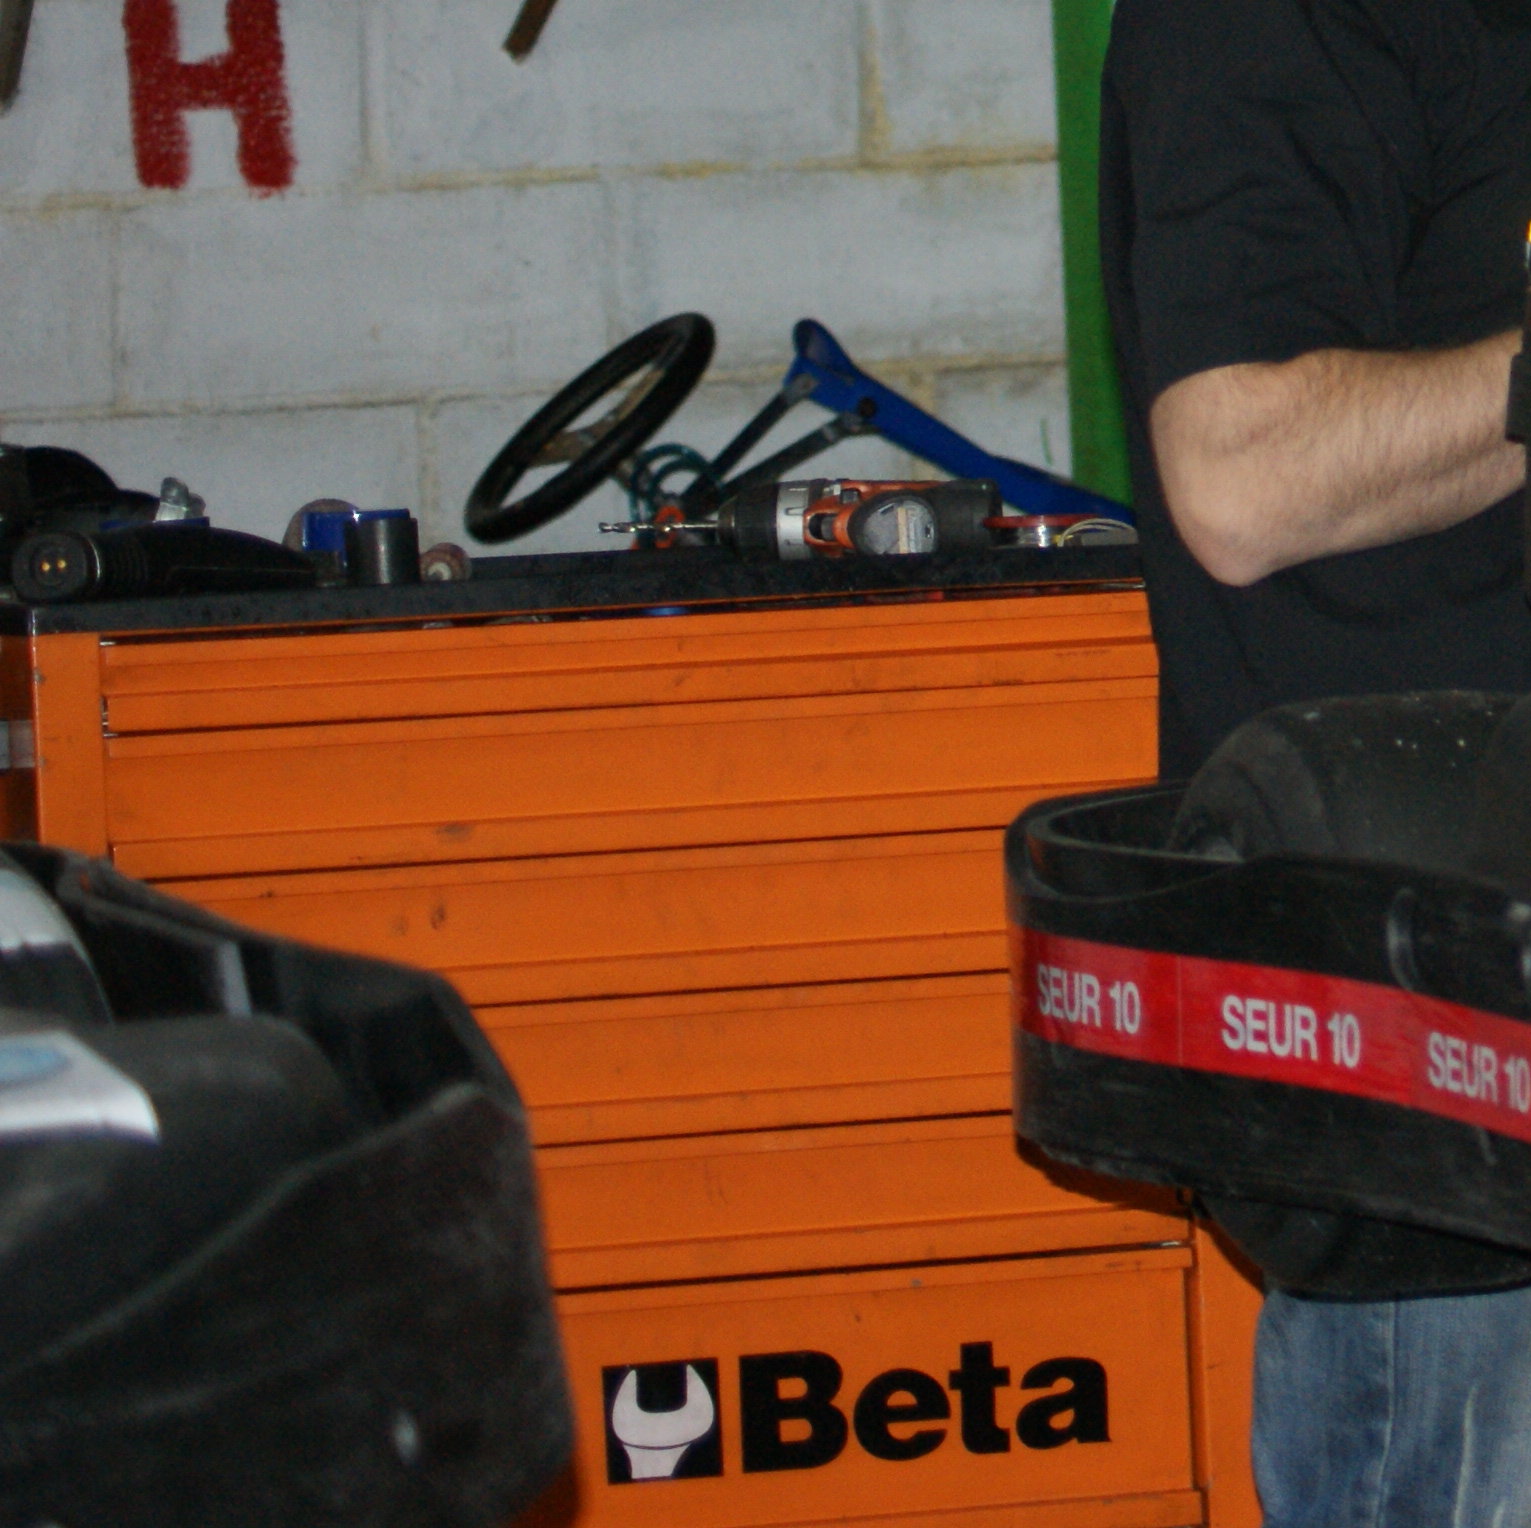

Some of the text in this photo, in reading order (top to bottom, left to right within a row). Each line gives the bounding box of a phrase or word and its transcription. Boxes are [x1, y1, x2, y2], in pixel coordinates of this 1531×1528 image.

[1037, 964, 1102, 1029] SEUR
[1108, 981, 1142, 1035] 10
[1221, 993, 1319, 1061] SEUR
[1327, 1012, 1362, 1069] 10
[1427, 1031, 1499, 1100] SEUR
[1504, 1058, 1531, 1114] 10
[738, 1340, 1112, 1475] Beta
